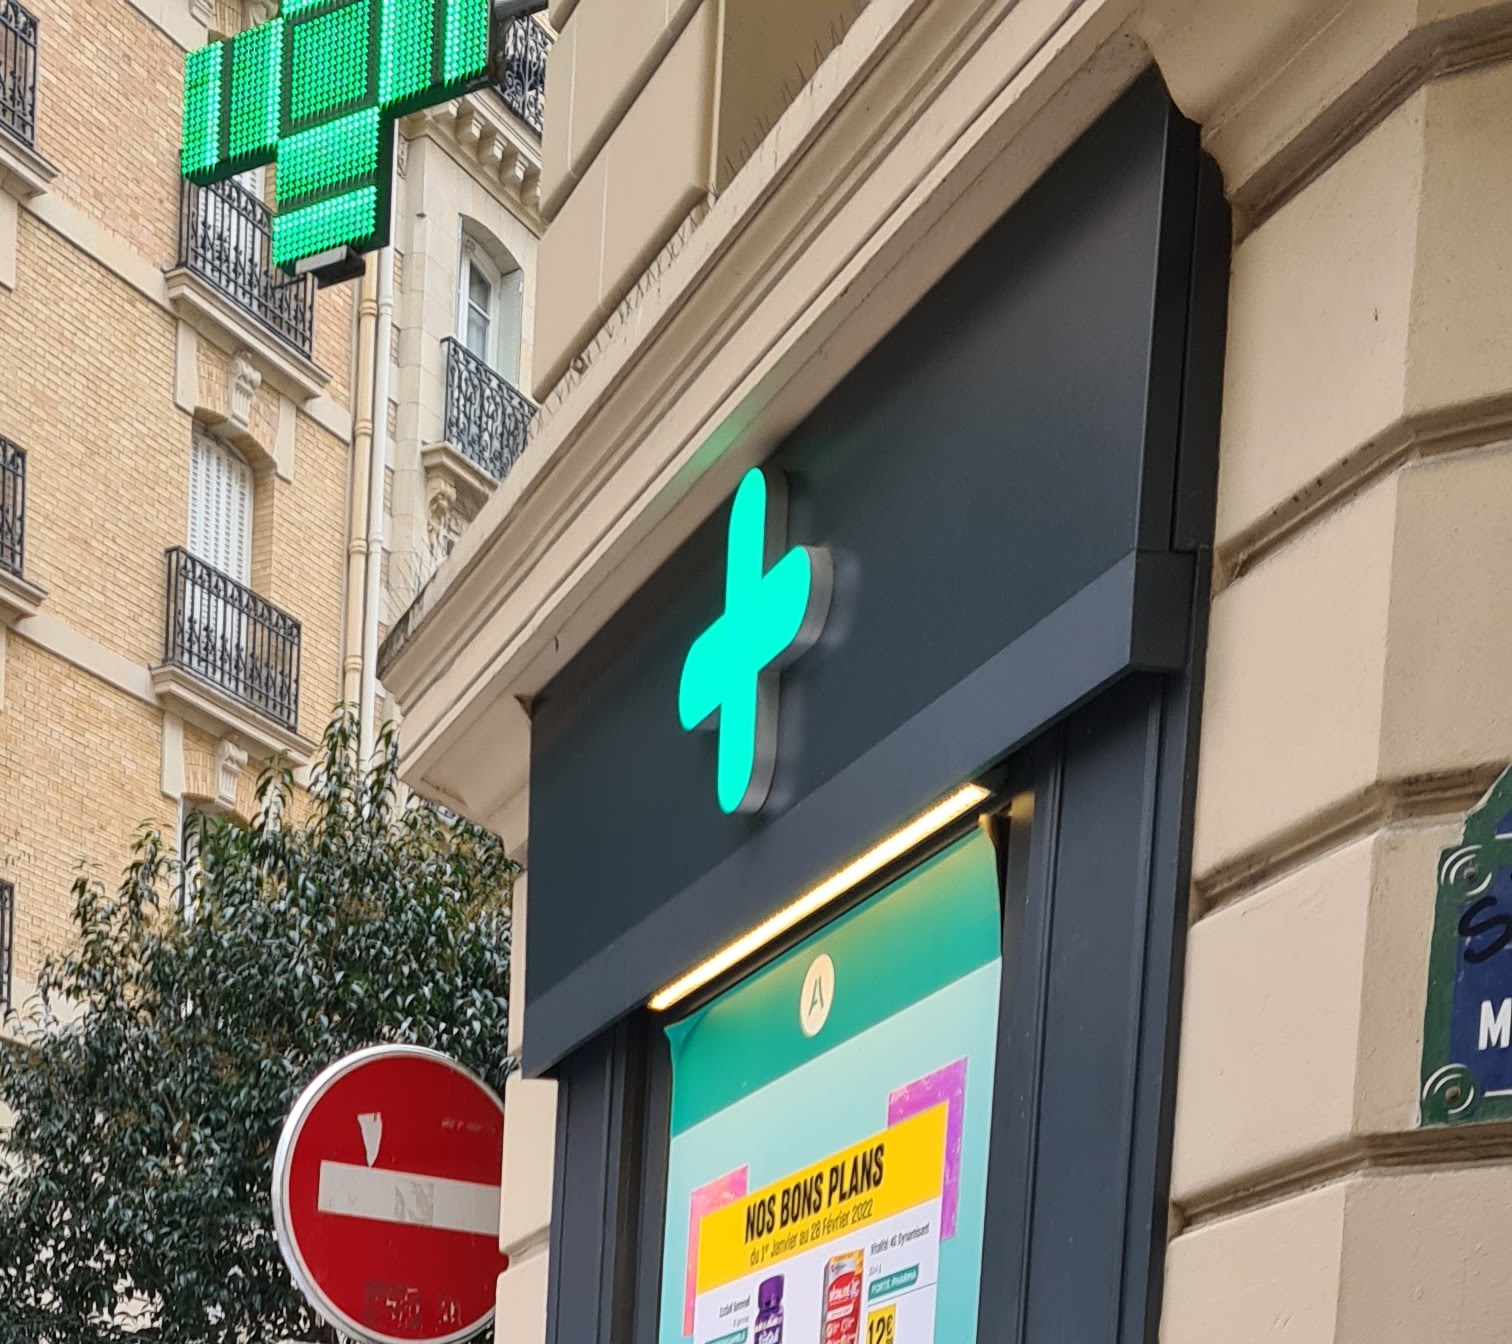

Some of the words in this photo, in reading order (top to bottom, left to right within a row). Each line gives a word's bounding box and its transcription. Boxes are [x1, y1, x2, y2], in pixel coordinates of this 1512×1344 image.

[745, 1194, 777, 1243] NOS
[779, 1173, 823, 1224] BONS
[827, 1144, 884, 1208] PLANS
[770, 1233, 797, 1258] Janvier
[800, 1230, 809, 1245] au
[822, 1208, 849, 1235] Février
[852, 1198, 873, 1226] 2022
